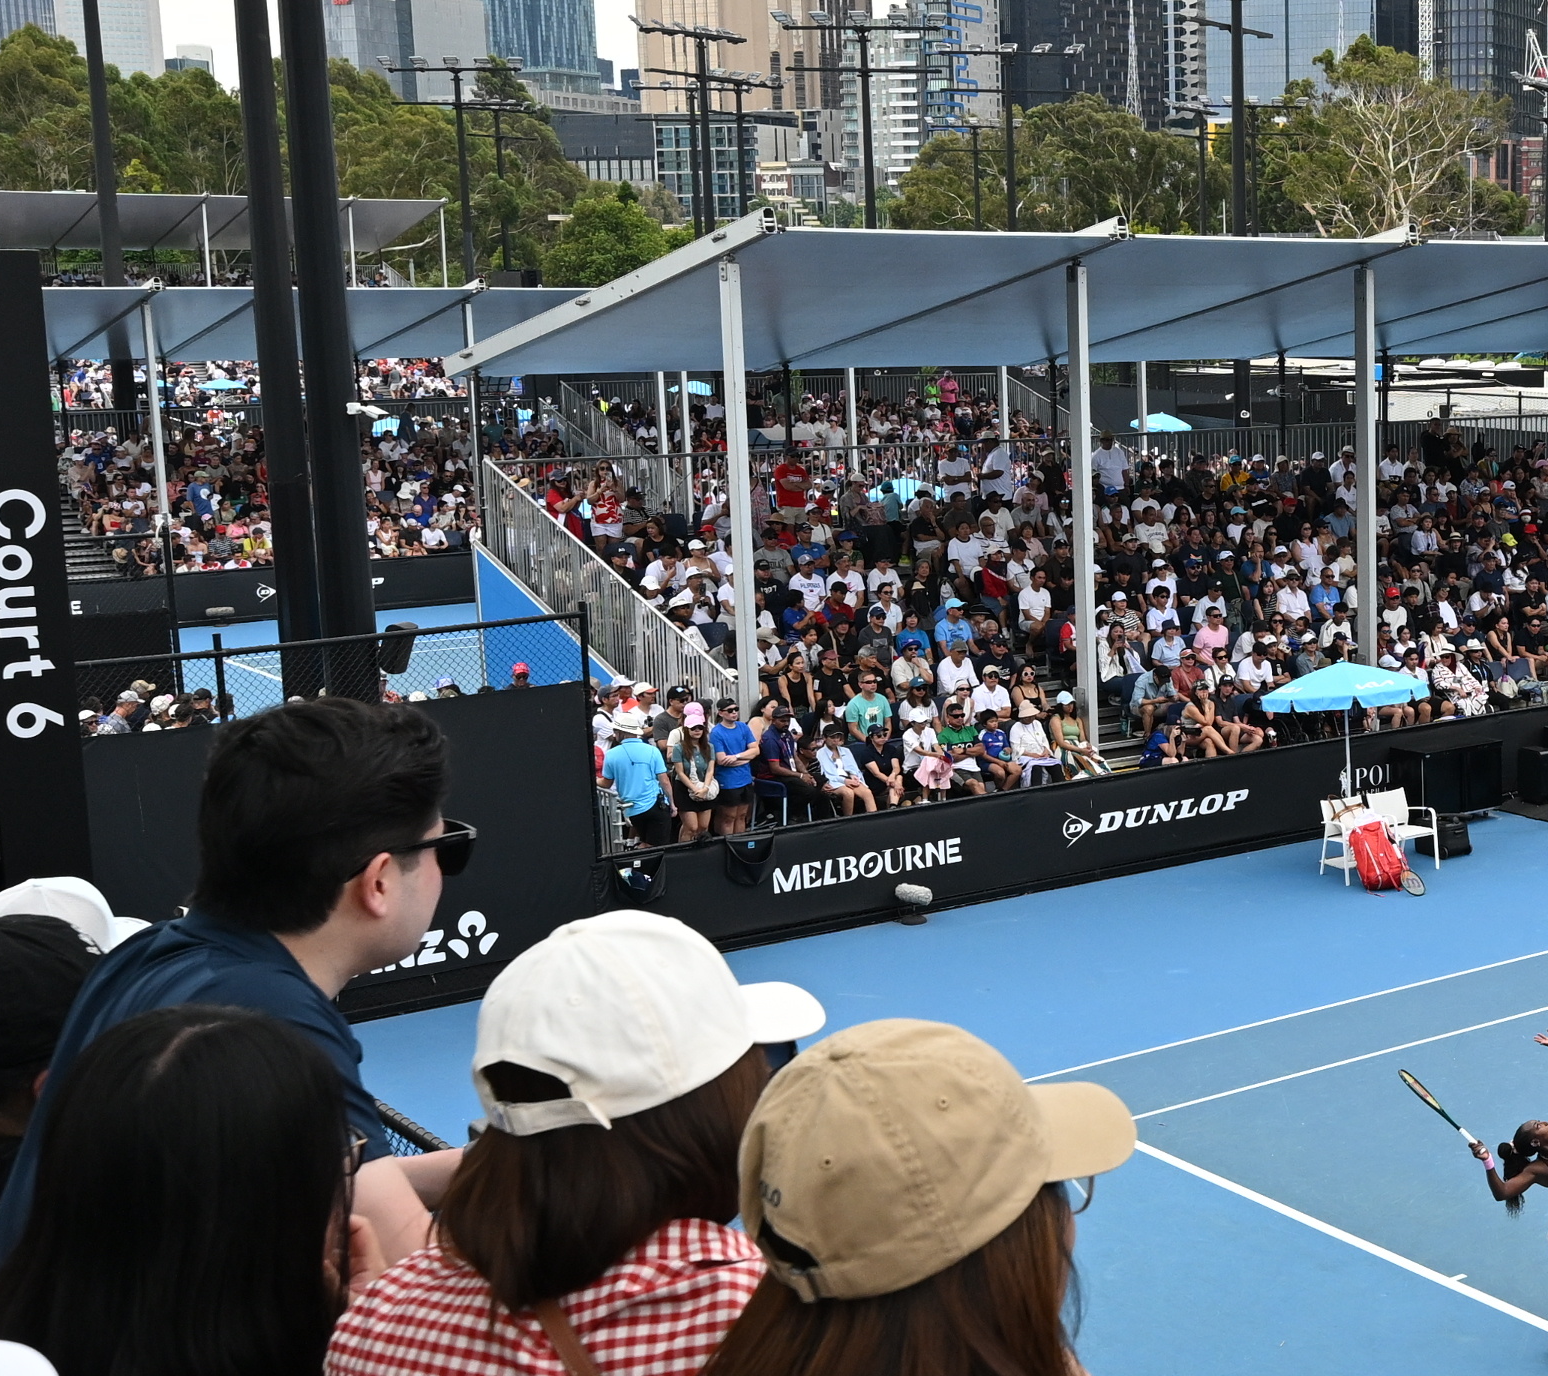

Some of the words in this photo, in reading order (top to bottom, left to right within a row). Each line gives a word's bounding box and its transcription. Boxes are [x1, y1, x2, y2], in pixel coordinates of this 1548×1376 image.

[6, 701, 65, 740] 6
[1095, 788, 1250, 834] DUNLOP
[772, 837, 963, 895] MELBOURNE
